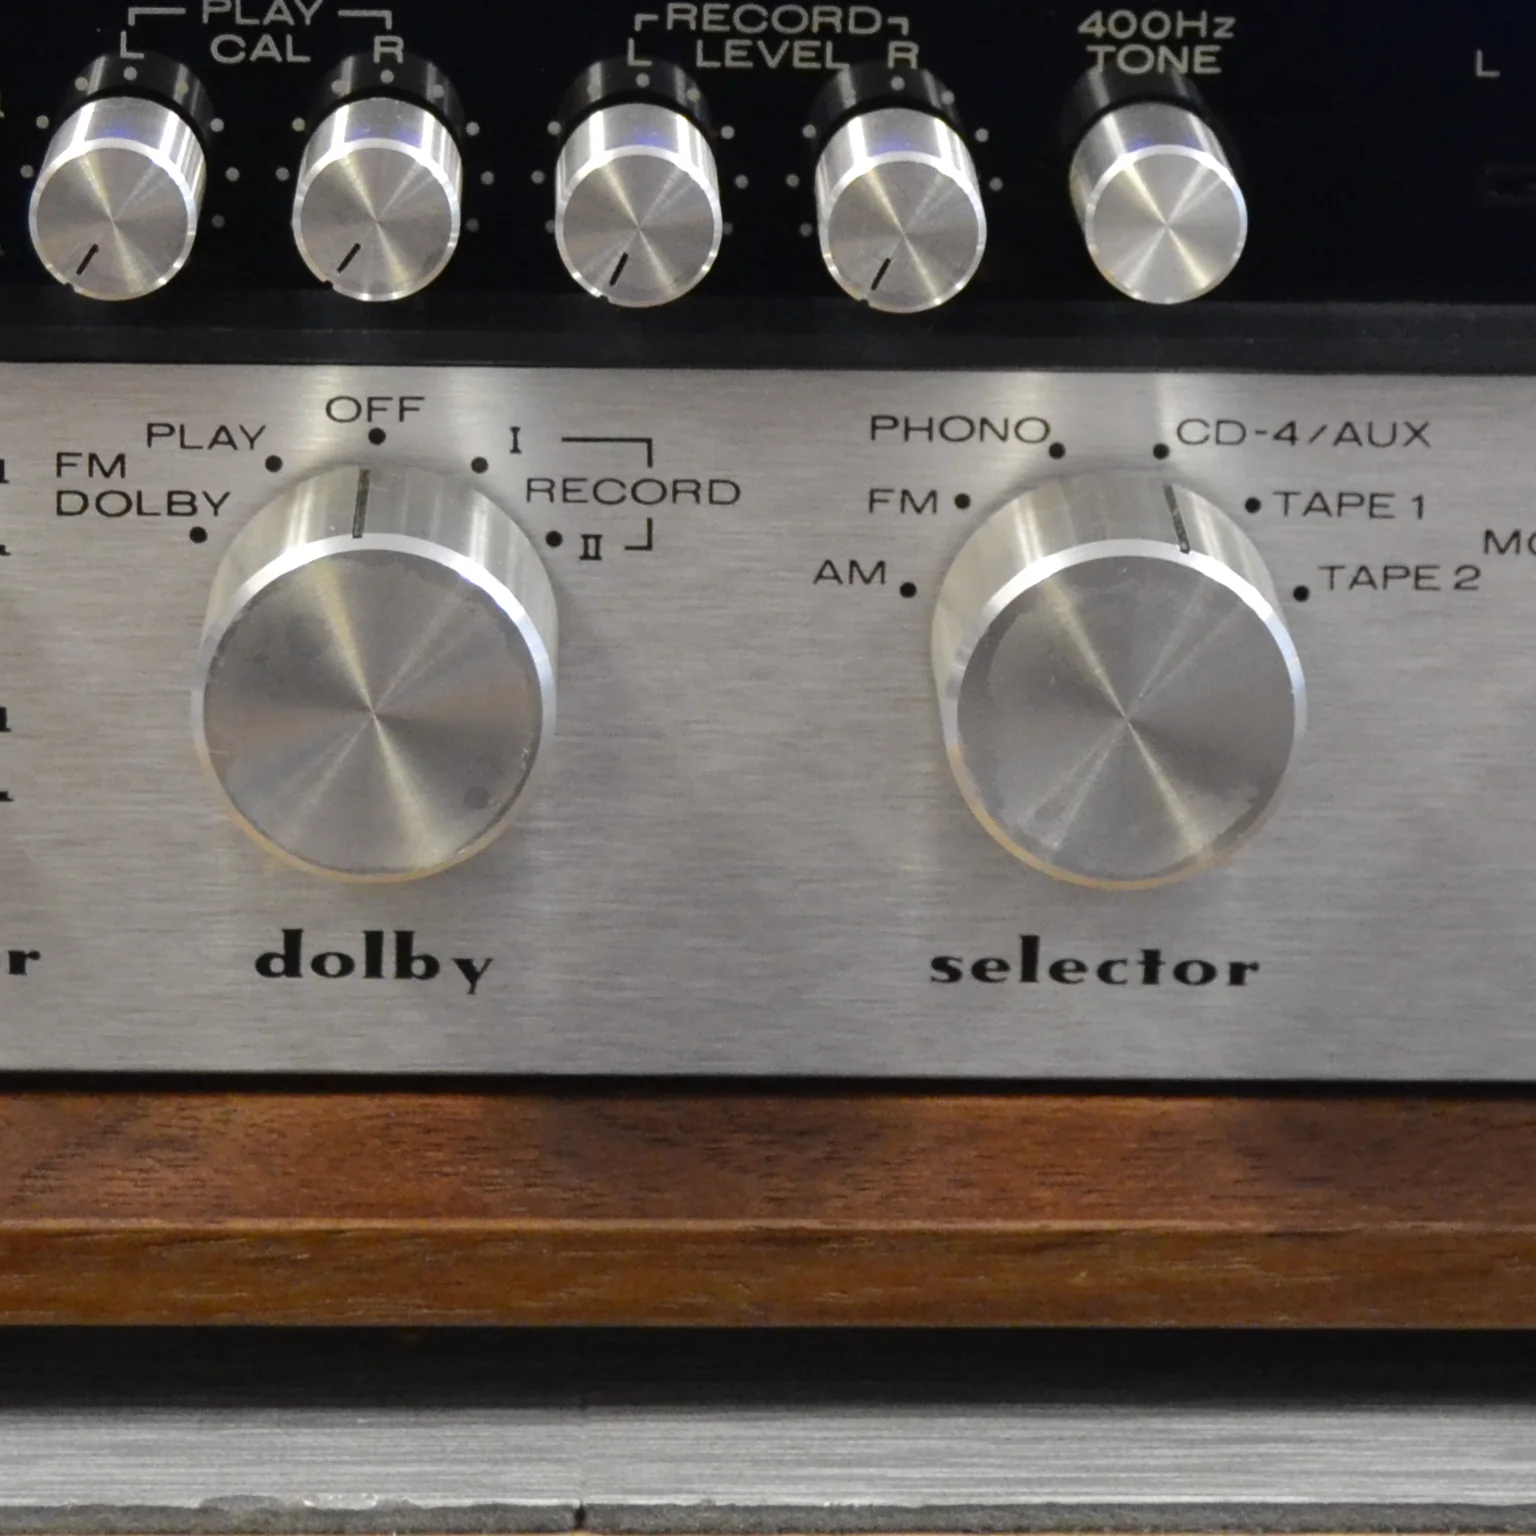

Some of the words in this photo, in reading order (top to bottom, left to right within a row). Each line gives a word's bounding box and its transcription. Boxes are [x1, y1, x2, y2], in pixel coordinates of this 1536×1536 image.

[666, 3, 882, 35] RECORD
[1077, 9, 1236, 40] 400Hz
[119, 30, 146, 60] L
[210, 32, 311, 64] CAL
[373, 35, 405, 64] R
[627, 37, 653, 67] L
[695, 39, 851, 69] LEVEL
[887, 40, 920, 71] R
[1086, 44, 1223, 75] TONE
[1474, 49, 1500, 78] L
[324, 396, 426, 424] OFF
[146, 422, 267, 451] PLAY
[868, 416, 1052, 445] PHONO
[1176, 418, 1432, 448] CD-4/AUX
[54, 452, 127, 479] FM
[54, 490, 231, 518] DOLBY
[525, 477, 742, 506] RECORD
[867, 487, 938, 514] FM
[1273, 490, 1401, 520] TAPE
[1411, 494, 1426, 520] 1
[812, 559, 887, 586] AM
[1318, 564, 1443, 592] TAPE
[1452, 565, 1482, 592] 2
[254, 928, 494, 995] dolby
[928, 934, 1260, 987] selector
